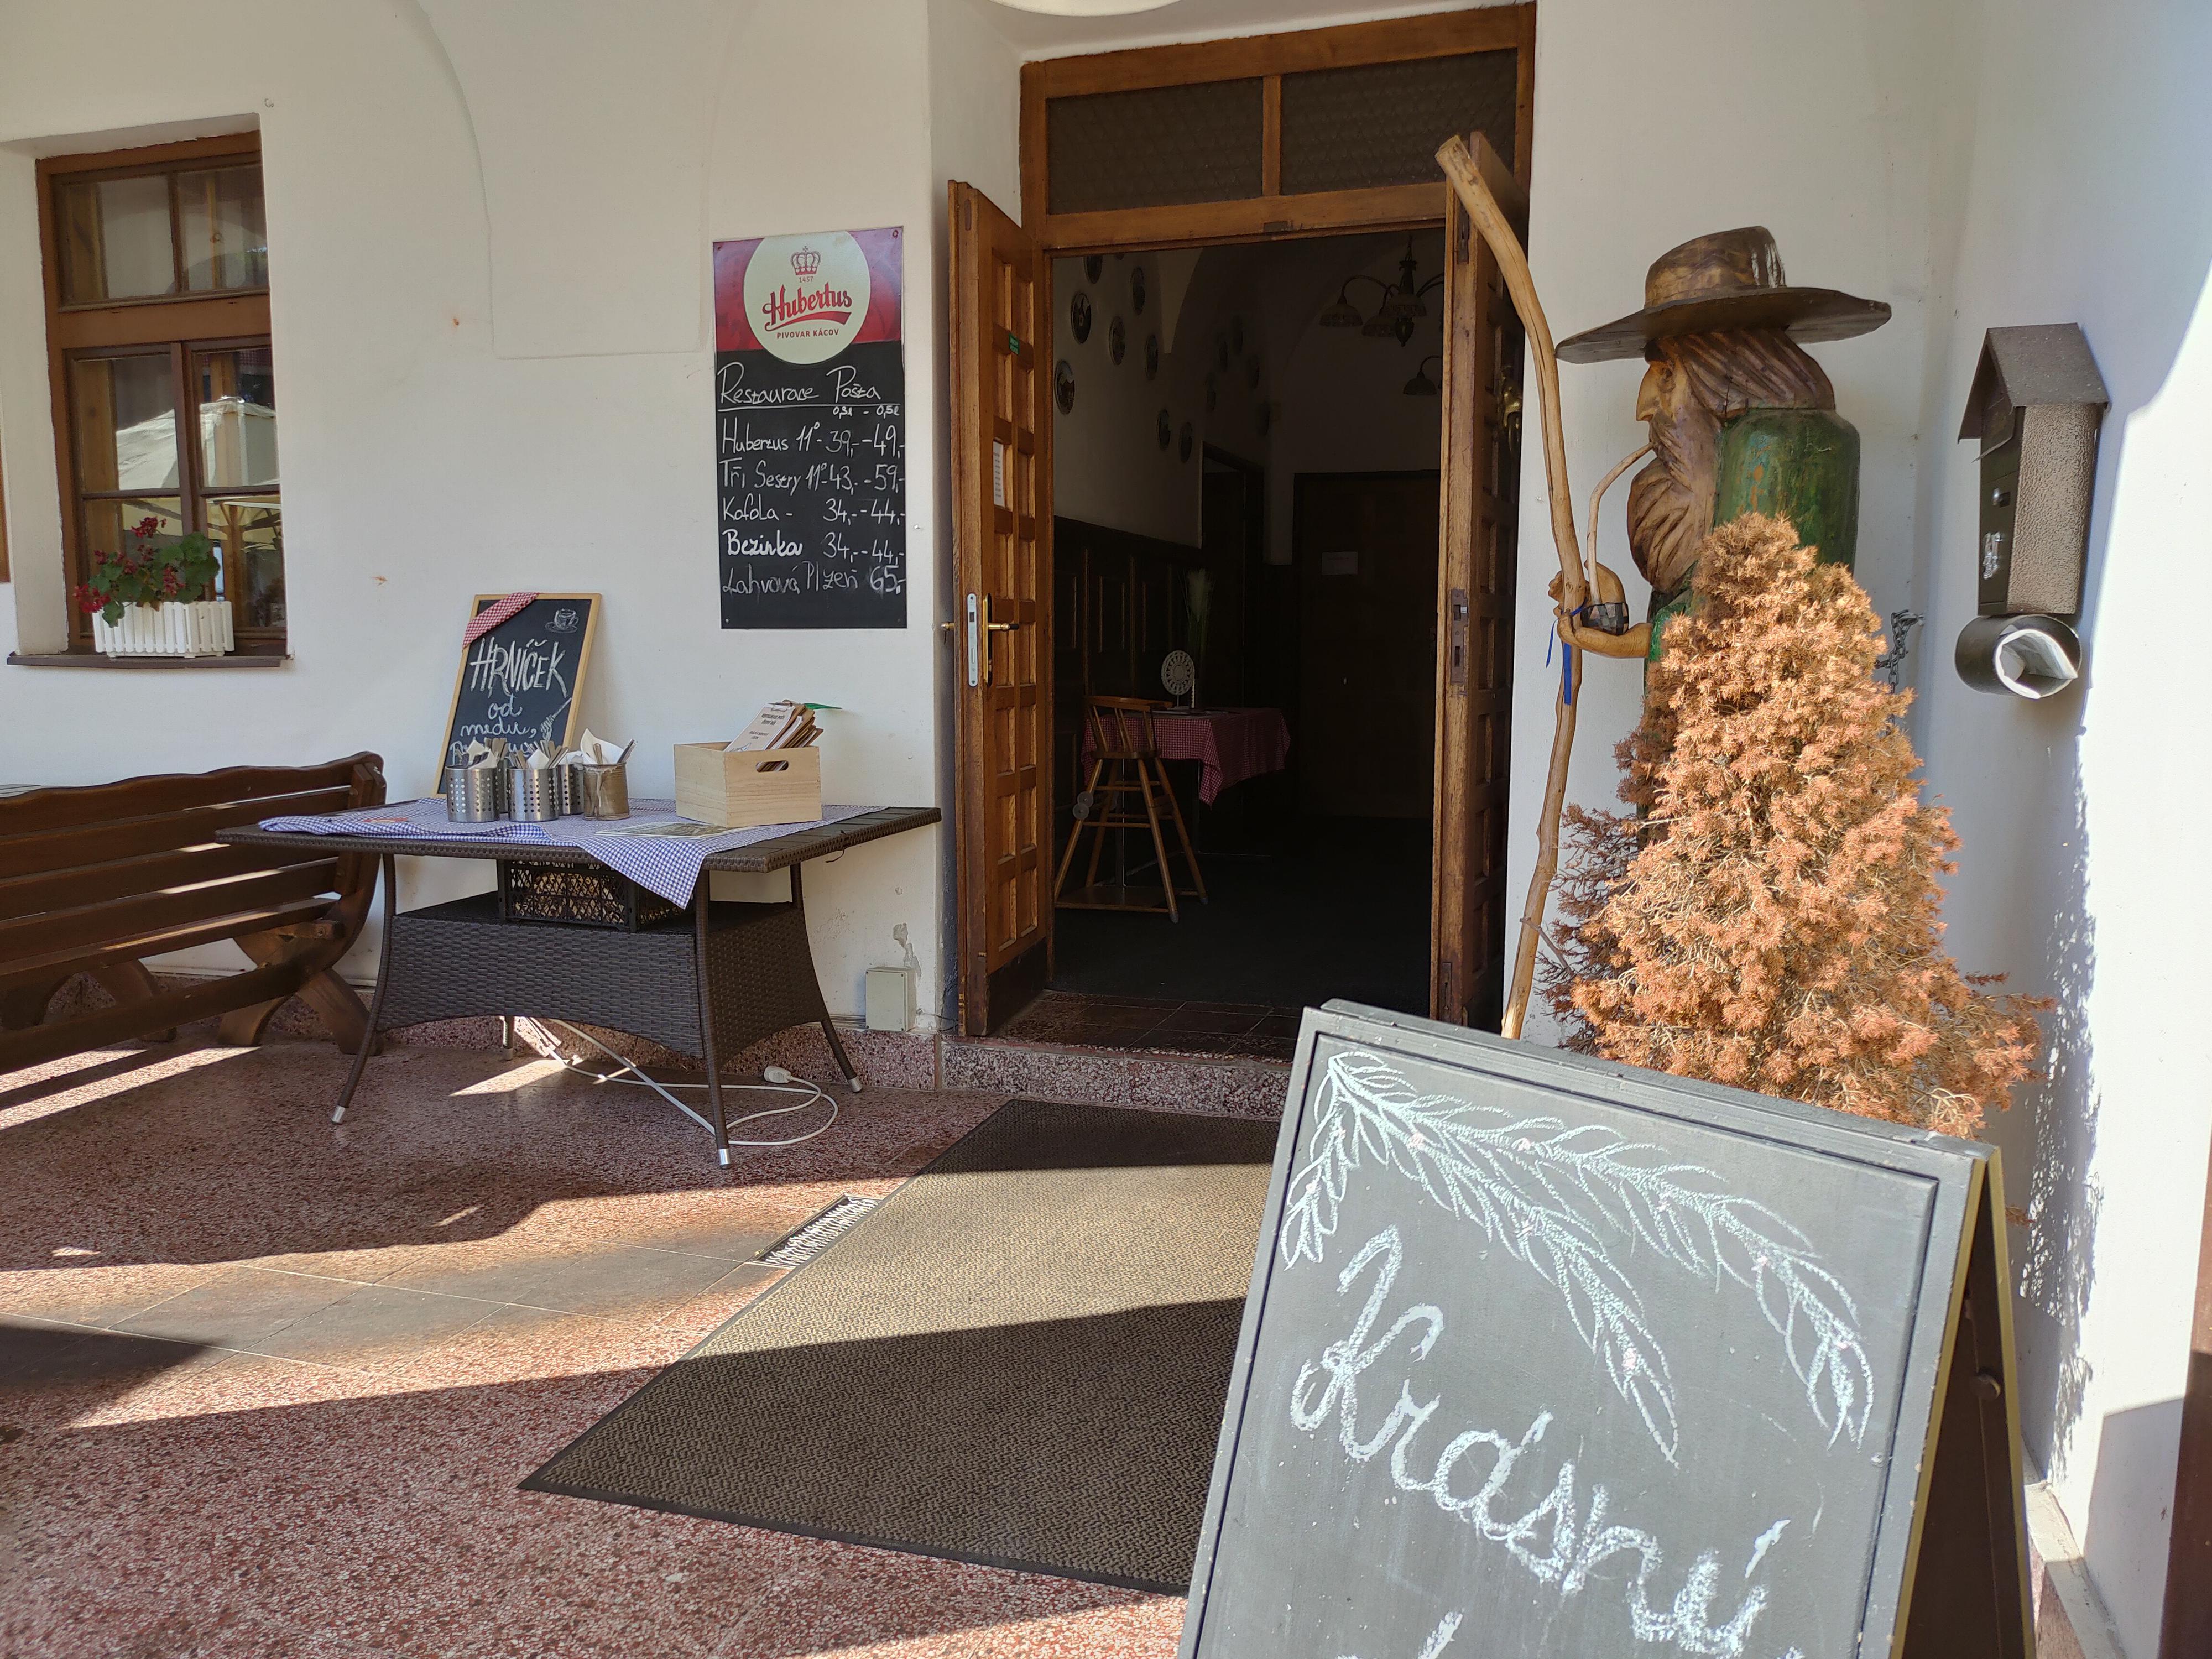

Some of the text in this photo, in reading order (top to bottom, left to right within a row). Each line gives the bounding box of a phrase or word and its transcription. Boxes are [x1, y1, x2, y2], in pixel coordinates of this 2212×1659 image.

[762, 282, 852, 326] Hubertus
[813, 328, 839, 336] KÁCOV
[717, 362, 881, 404] Restaurace Pošta
[754, 460, 801, 496] Sestry
[722, 529, 802, 557] Bezinka
[470, 637, 569, 698] HRNÍČEK
[488, 695, 523, 720] od
